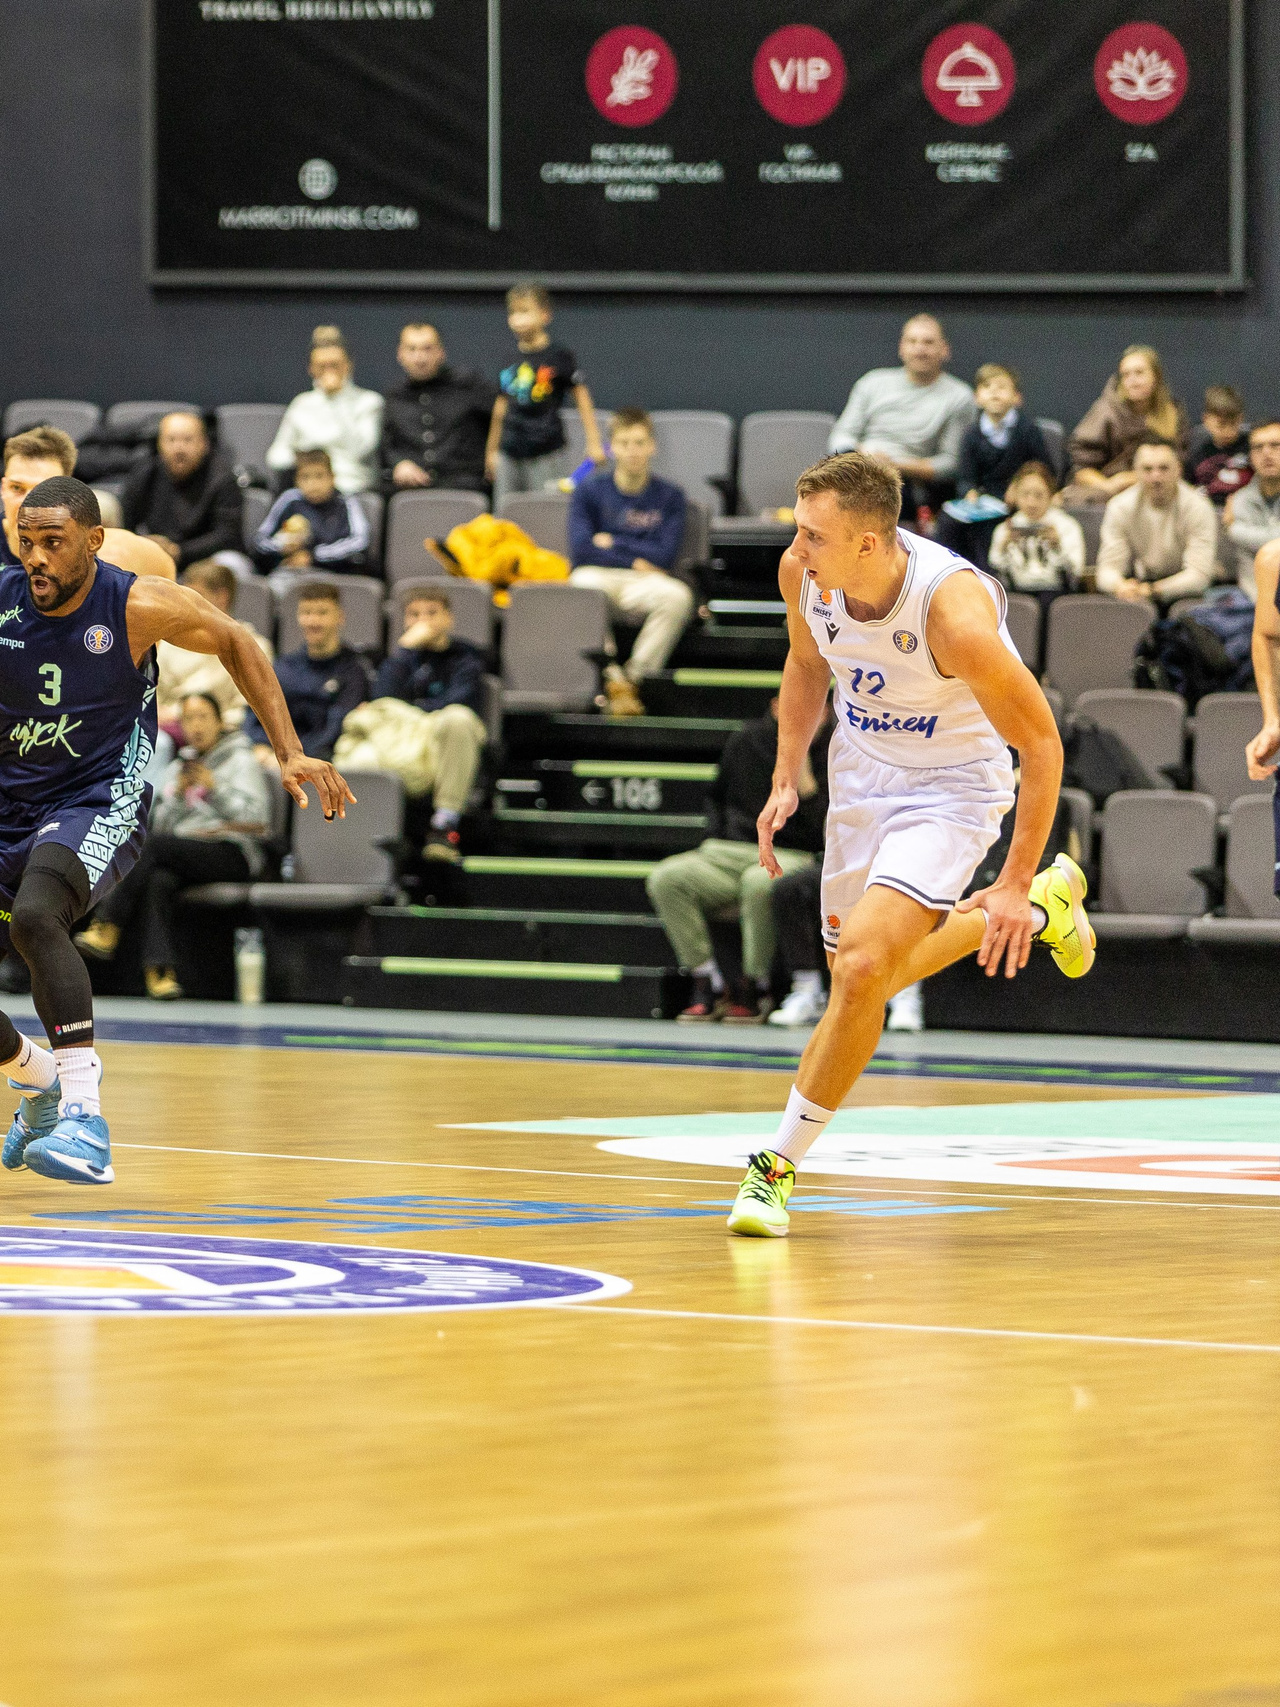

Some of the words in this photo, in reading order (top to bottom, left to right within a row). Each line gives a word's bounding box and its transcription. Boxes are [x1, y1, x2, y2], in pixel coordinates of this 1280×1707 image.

[769, 56, 832, 94] VIP
[38, 663, 62, 706] 3
[848, 667, 886, 699] 12
[845, 700, 939, 739] Enisey
